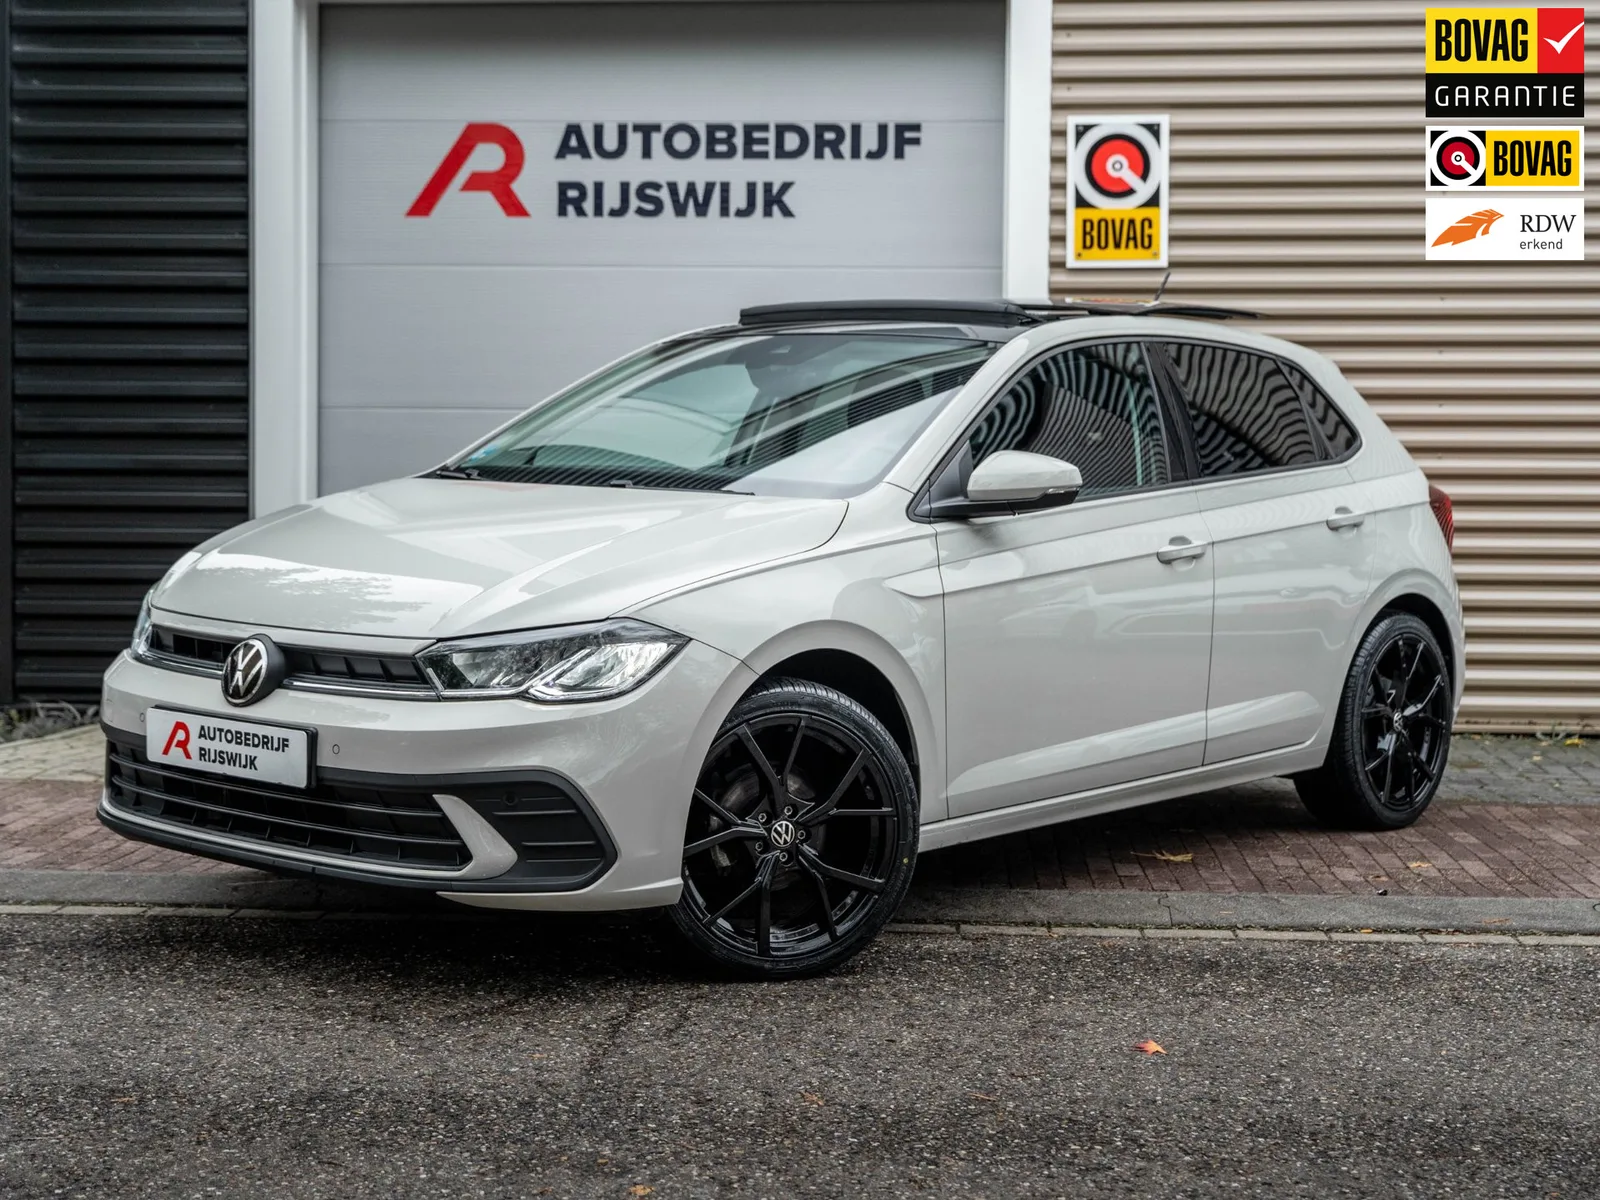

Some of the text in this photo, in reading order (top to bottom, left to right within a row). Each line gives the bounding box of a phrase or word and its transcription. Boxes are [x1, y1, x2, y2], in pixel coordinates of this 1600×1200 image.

[555, 122, 922, 160] AUTOBEDRIJF
[556, 181, 796, 218] RIJSWIJK
[1082, 217, 1153, 250] BOVAG
[198, 725, 290, 753] AUTOBEDRIJF
[198, 747, 258, 771] RIJSWIJK
